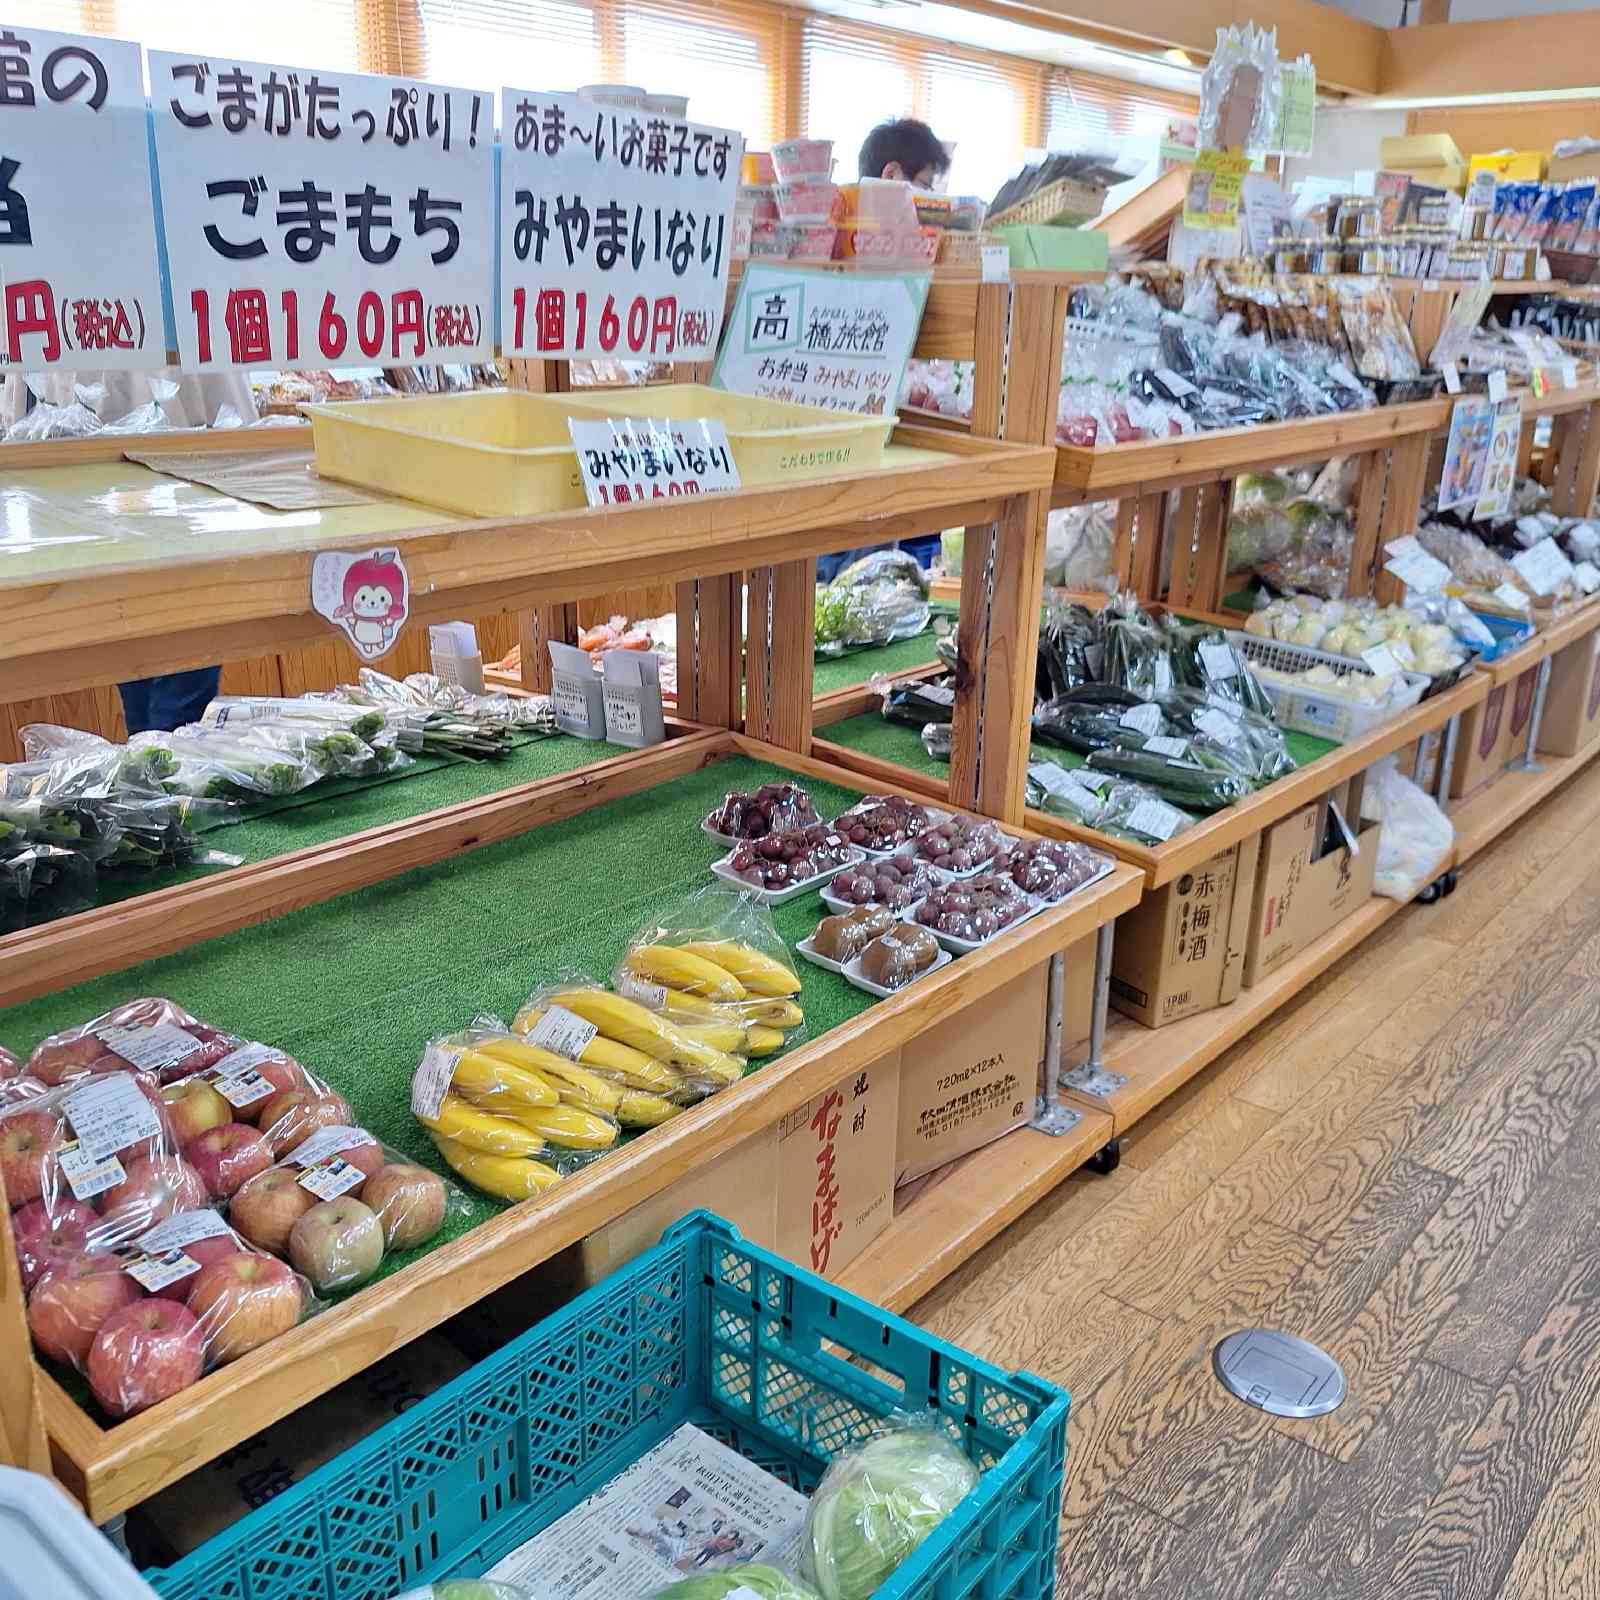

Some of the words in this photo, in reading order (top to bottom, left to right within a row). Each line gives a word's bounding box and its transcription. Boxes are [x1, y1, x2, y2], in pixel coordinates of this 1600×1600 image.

[203, 175, 463, 265] ごまもち
[512, 190, 725, 279] みやまいなり
[752, 293, 790, 341] 高
[757, 356, 809, 384] お弁当
[585, 446, 730, 479] みやまいなり
[1186, 871, 1216, 963] 赤梅酒
[924, 1128, 939, 1141] TEL
[810, 1089, 844, 1274] なまはげ
